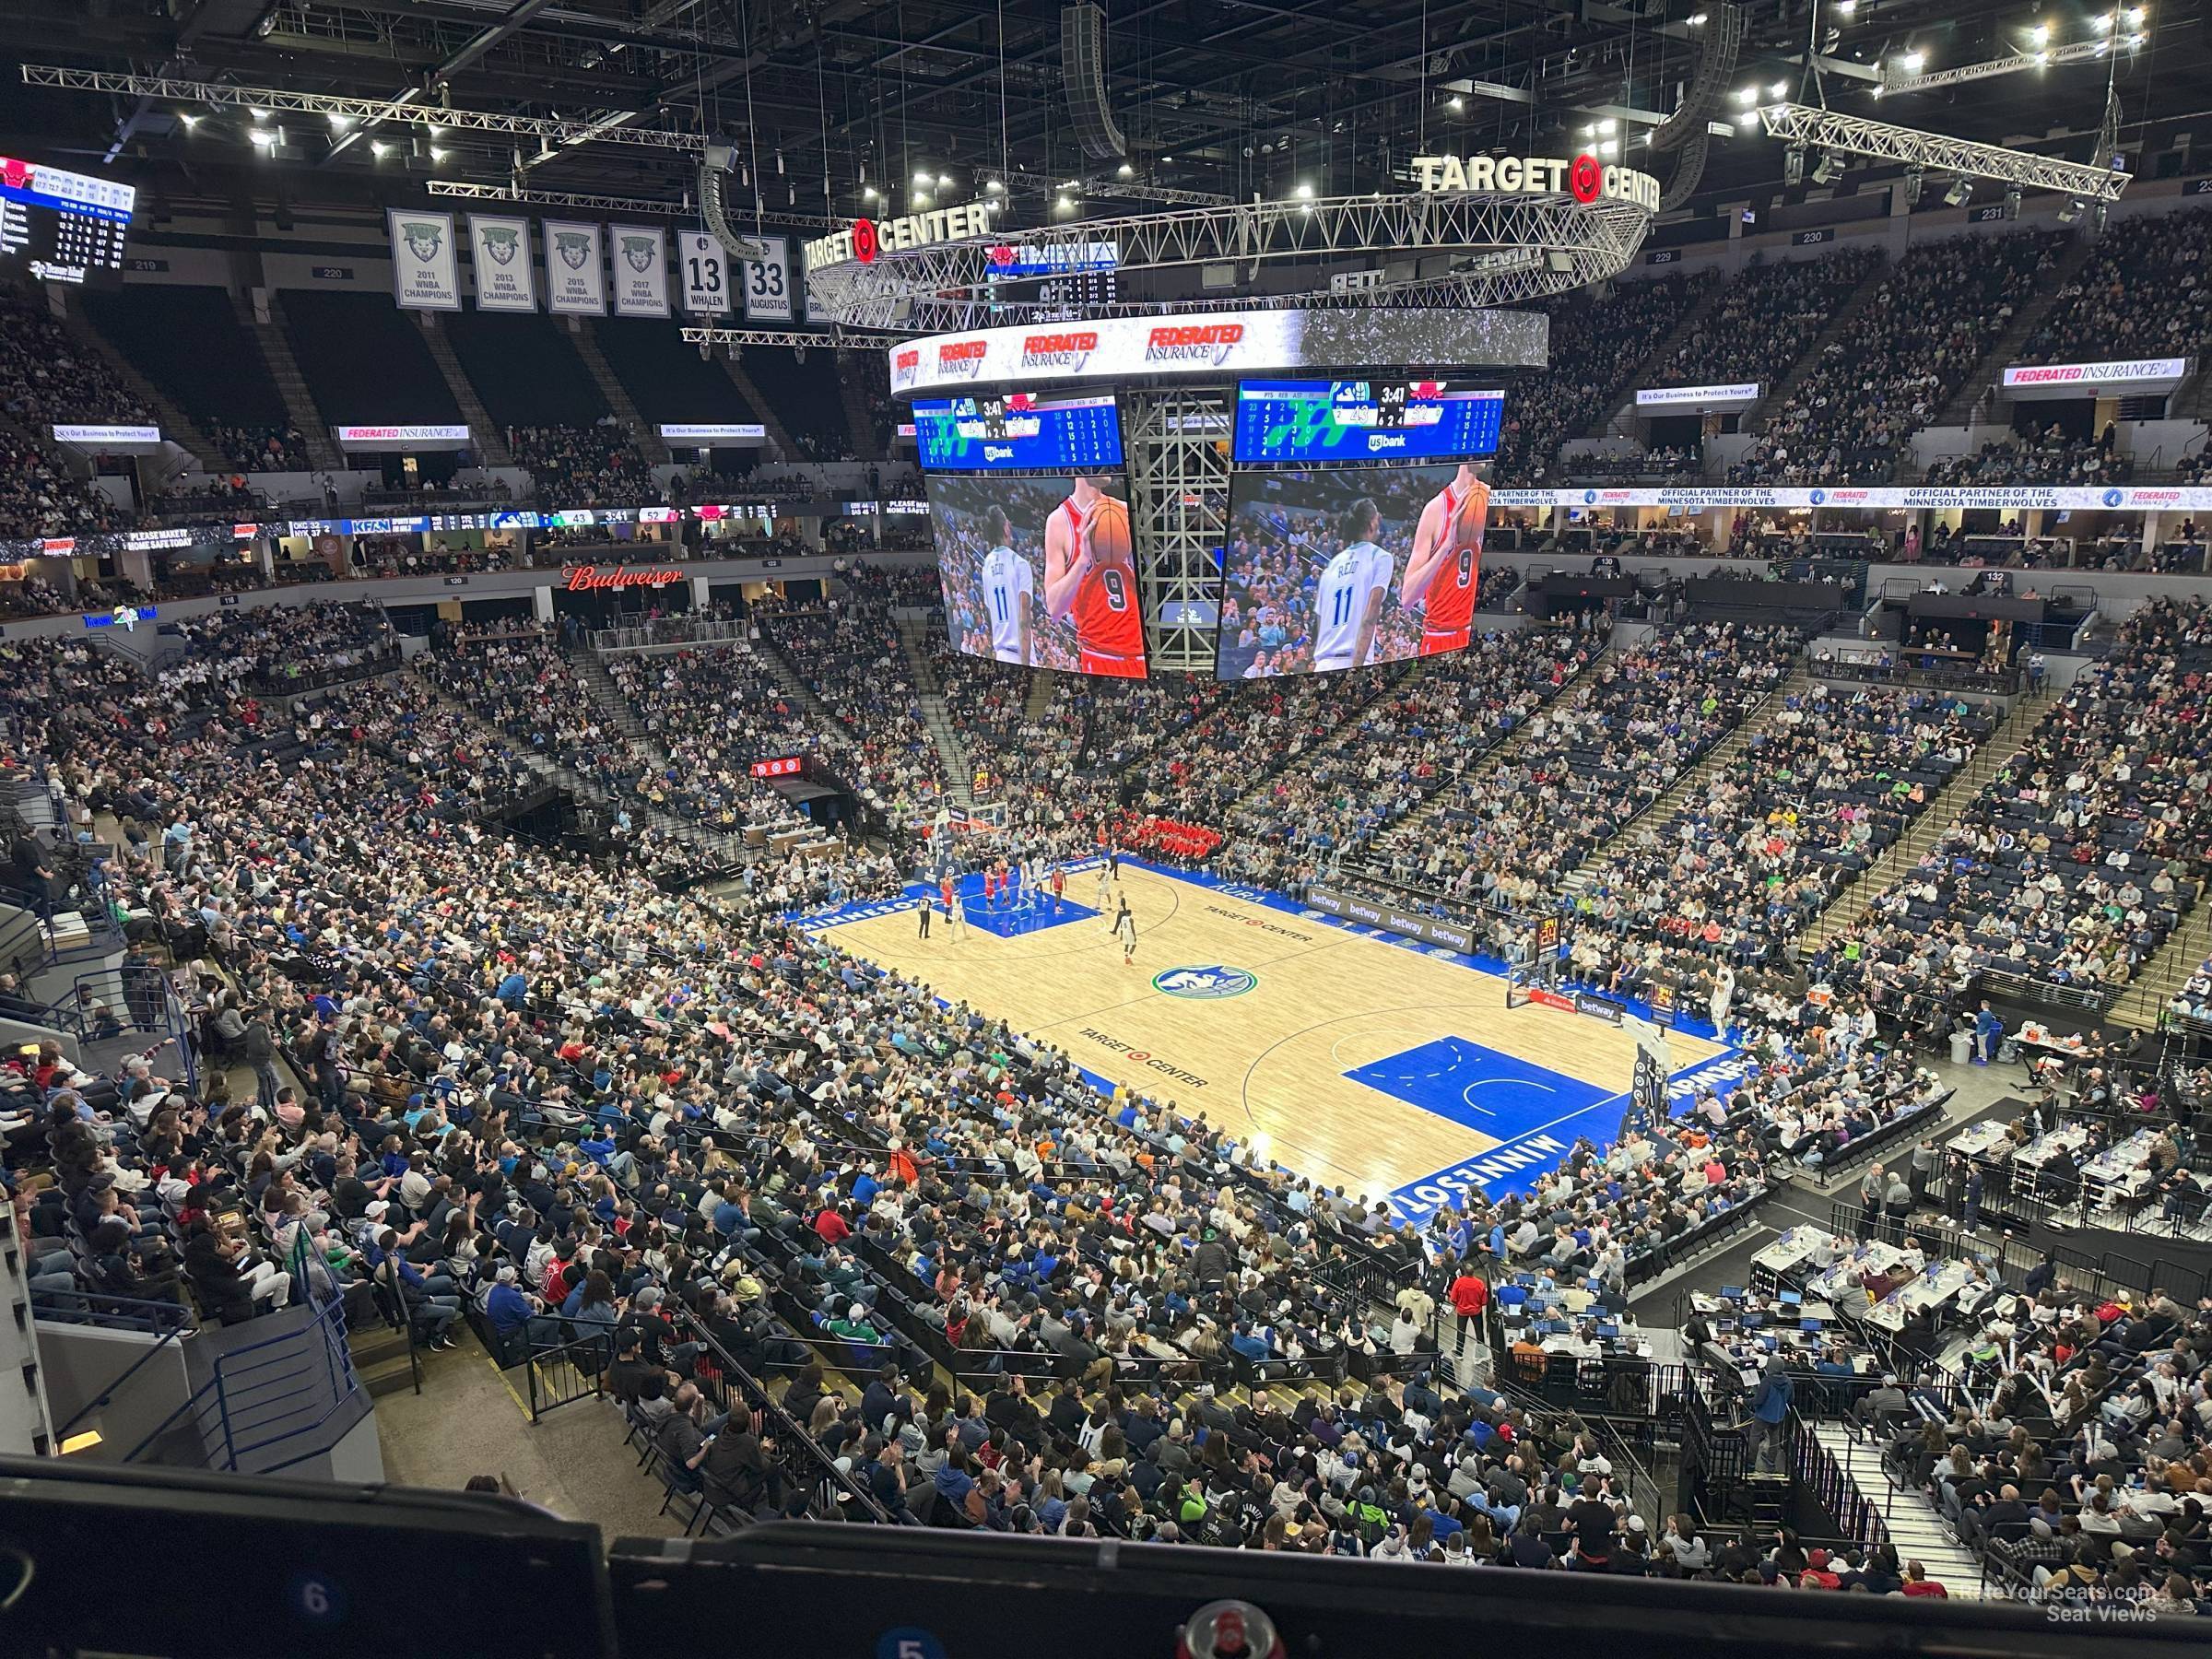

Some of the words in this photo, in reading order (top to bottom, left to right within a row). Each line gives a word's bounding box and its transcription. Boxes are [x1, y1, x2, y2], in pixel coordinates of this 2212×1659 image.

[1413, 156, 1568, 192] TARGET
[1983, 206, 2003, 221] 231
[805, 230, 854, 273] TARGET
[877, 203, 988, 253] CENTER
[1804, 231, 1822, 243] 230
[1655, 253, 1672, 264] 229
[135, 261, 156, 271] 219
[324, 268, 342, 278] 220
[417, 271, 435, 280] 2011
[495, 274, 514, 283] 2013
[688, 257, 721, 292] 13
[415, 280, 441, 289] WNBA
[567, 277, 584, 287] 2015
[632, 280, 649, 289] 2017
[749, 263, 784, 297] 33
[493, 283, 517, 292] WNBA
[565, 287, 587, 296] WNBA
[404, 289, 453, 300] CHAMPIONS
[483, 292, 529, 302] CHAMPIONS
[630, 289, 653, 298] WNBA
[555, 295, 599, 306] CHAMPIONS
[621, 298, 663, 309] CHAMPIONS
[690, 294, 724, 307] WHALEN
[749, 298, 788, 311] AUGUSTUS
[1148, 324, 1245, 347] FEDERATED
[1023, 332, 1100, 354] FEDERATED
[1145, 344, 1211, 361] INSURANCE
[1021, 352, 1072, 368] INSURANCE
[2013, 368, 2082, 382] FEDERATED
[2081, 363, 2160, 379] INSURANCE
[1381, 387, 1406, 403] 3:41
[983, 401, 1002, 416] 3:41
[1265, 403, 1271, 411] 4
[1280, 403, 1285, 411] 2
[1066, 411, 1072, 419] 0
[1102, 408, 1107, 417] 2
[1264, 415, 1270, 423] 5
[1067, 421, 1074, 429] 12
[1091, 420, 1096, 429] 2
[1378, 417, 1383, 425] 6
[1387, 415, 1394, 427] 2
[1397, 417, 1403, 425] 4
[82, 429, 108, 438] Business
[347, 429, 399, 438] FEDERATED
[399, 428, 453, 438] INSURANCE
[994, 428, 999, 438] 2
[1264, 426, 1269, 434] 7
[1291, 426, 1298, 434] 3
[1069, 432, 1076, 441] 15
[1262, 437, 1268, 445] 3
[1382, 435, 1406, 447] bank
[1094, 441, 1099, 450] 3
[995, 446, 1014, 458] bank
[1072, 453, 1077, 462] 5
[1095, 452, 1100, 460] 4
[1261, 448, 1267, 456] 4
[1276, 448, 1281, 456] 3
[1909, 488, 1956, 498] OFFICIAL
[1959, 488, 2009, 498] PARTNER
[2013, 488, 2027, 498] OF
[2031, 488, 2053, 498] THE
[2133, 492, 2181, 500] FEDERATED
[1658, 497, 1705, 505] MINNESOTA
[1903, 498, 1964, 507] MINNESOTA
[1968, 499, 2057, 507] TIMBERWOLVES
[573, 513, 585, 524] 43
[606, 511, 627, 522] 3:41
[647, 512, 658, 521] 52
[353, 520, 389, 534] KFAN
[130, 532, 159, 541] PLEASE
[159, 530, 180, 539] MAKE
[127, 541, 150, 550] HOME
[151, 540, 170, 549] SAFE
[171, 537, 193, 547] TODAY
[1338, 561, 1359, 578] REID
[1457, 549, 1473, 588] 9
[562, 566, 683, 591] Budweiser
[1987, 571, 2003, 581] 132
[1103, 570, 1127, 611] 9
[994, 586, 1008, 621] 11
[1334, 585, 1354, 626] 11
[1312, 892, 1341, 911] betway
[1349, 903, 1381, 922] betway
[1204, 904, 1247, 923] TARGET
[1260, 924, 1312, 942] CENTER
[1390, 915, 1423, 935] betway
[1431, 926, 1466, 947] betway
[1541, 928, 1556, 945] 24
[1581, 1000, 1615, 1018] betway
[1079, 1028, 1135, 1053] TARGET
[1147, 1059, 1209, 1088] CENTER
[1062, 1431, 1076, 1449] 11
[303, 1583, 327, 1613] 6
